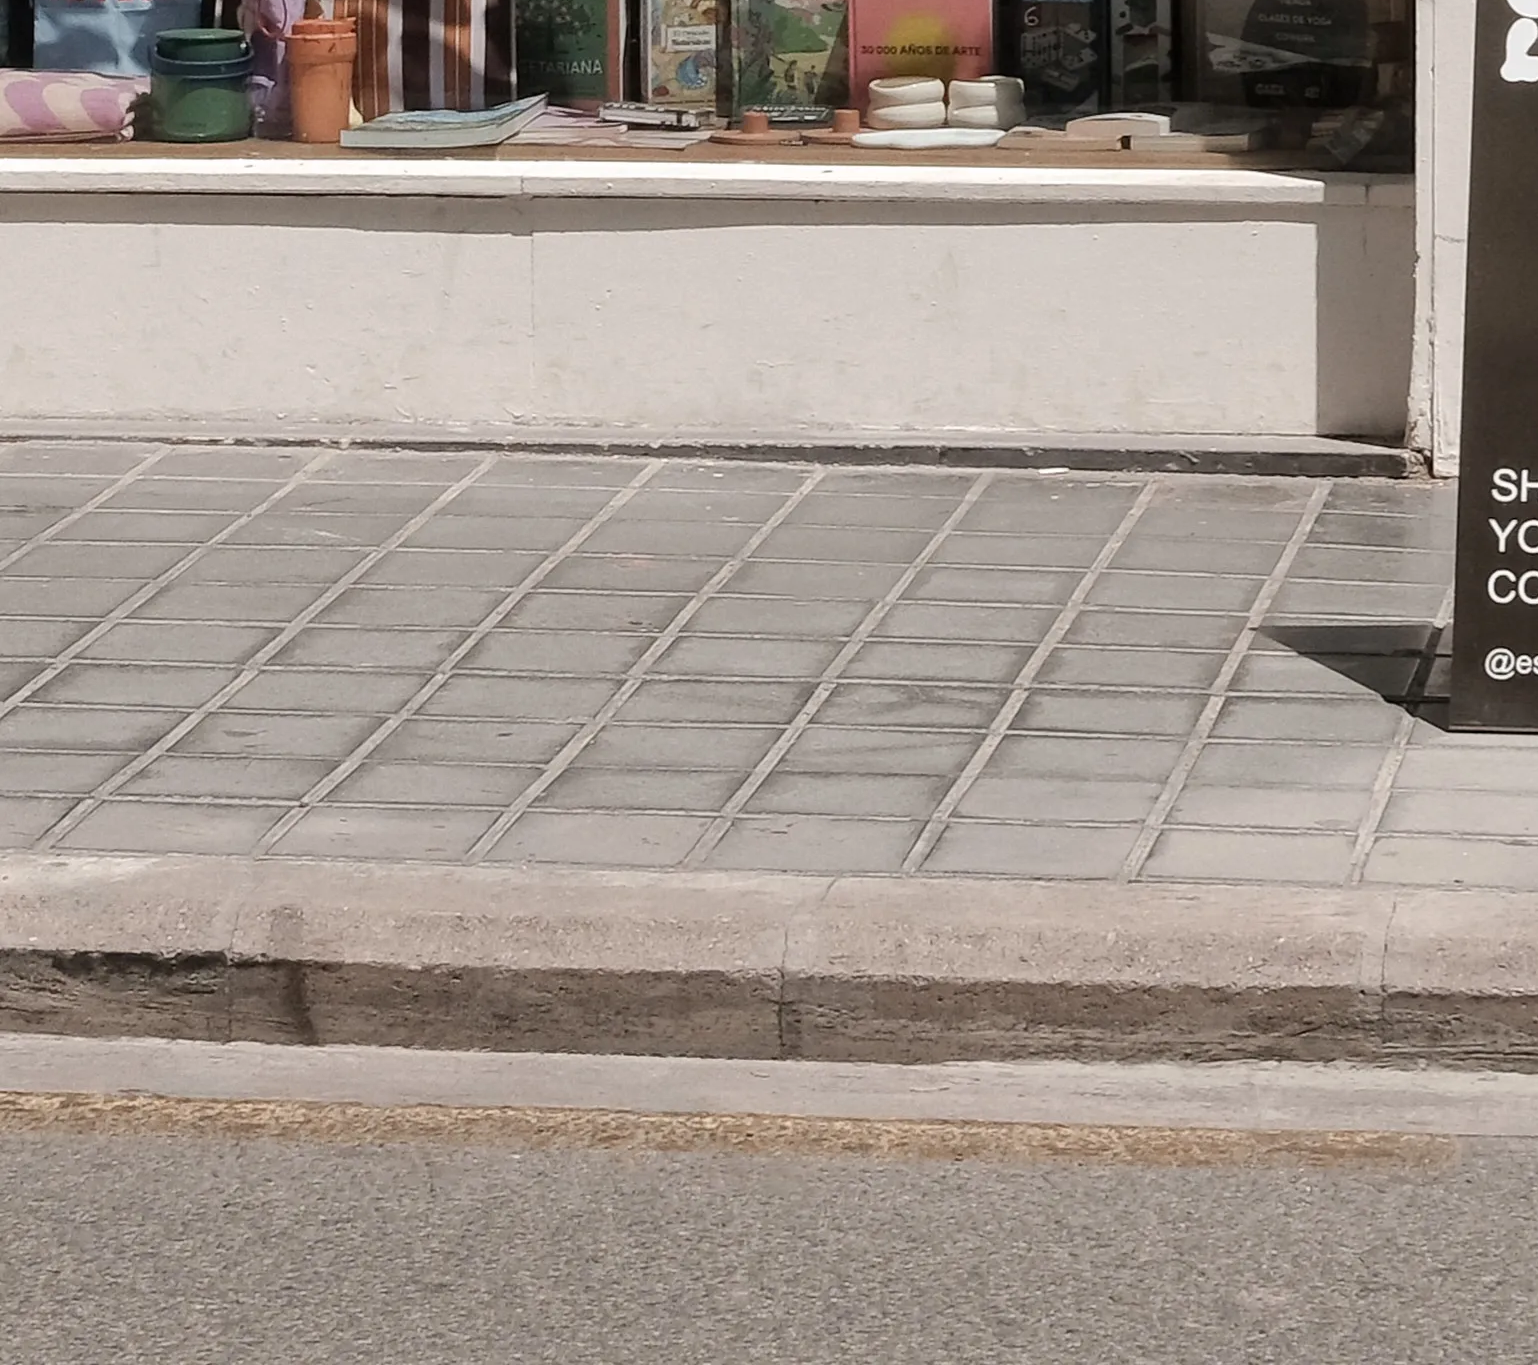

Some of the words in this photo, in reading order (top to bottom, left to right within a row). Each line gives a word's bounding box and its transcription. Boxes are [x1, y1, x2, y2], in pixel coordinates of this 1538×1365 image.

[1023, 7, 1039, 27] 6
[899, 43, 933, 56] AÑOS
[934, 46, 950, 56] DE
[951, 46, 982, 56] ARTE
